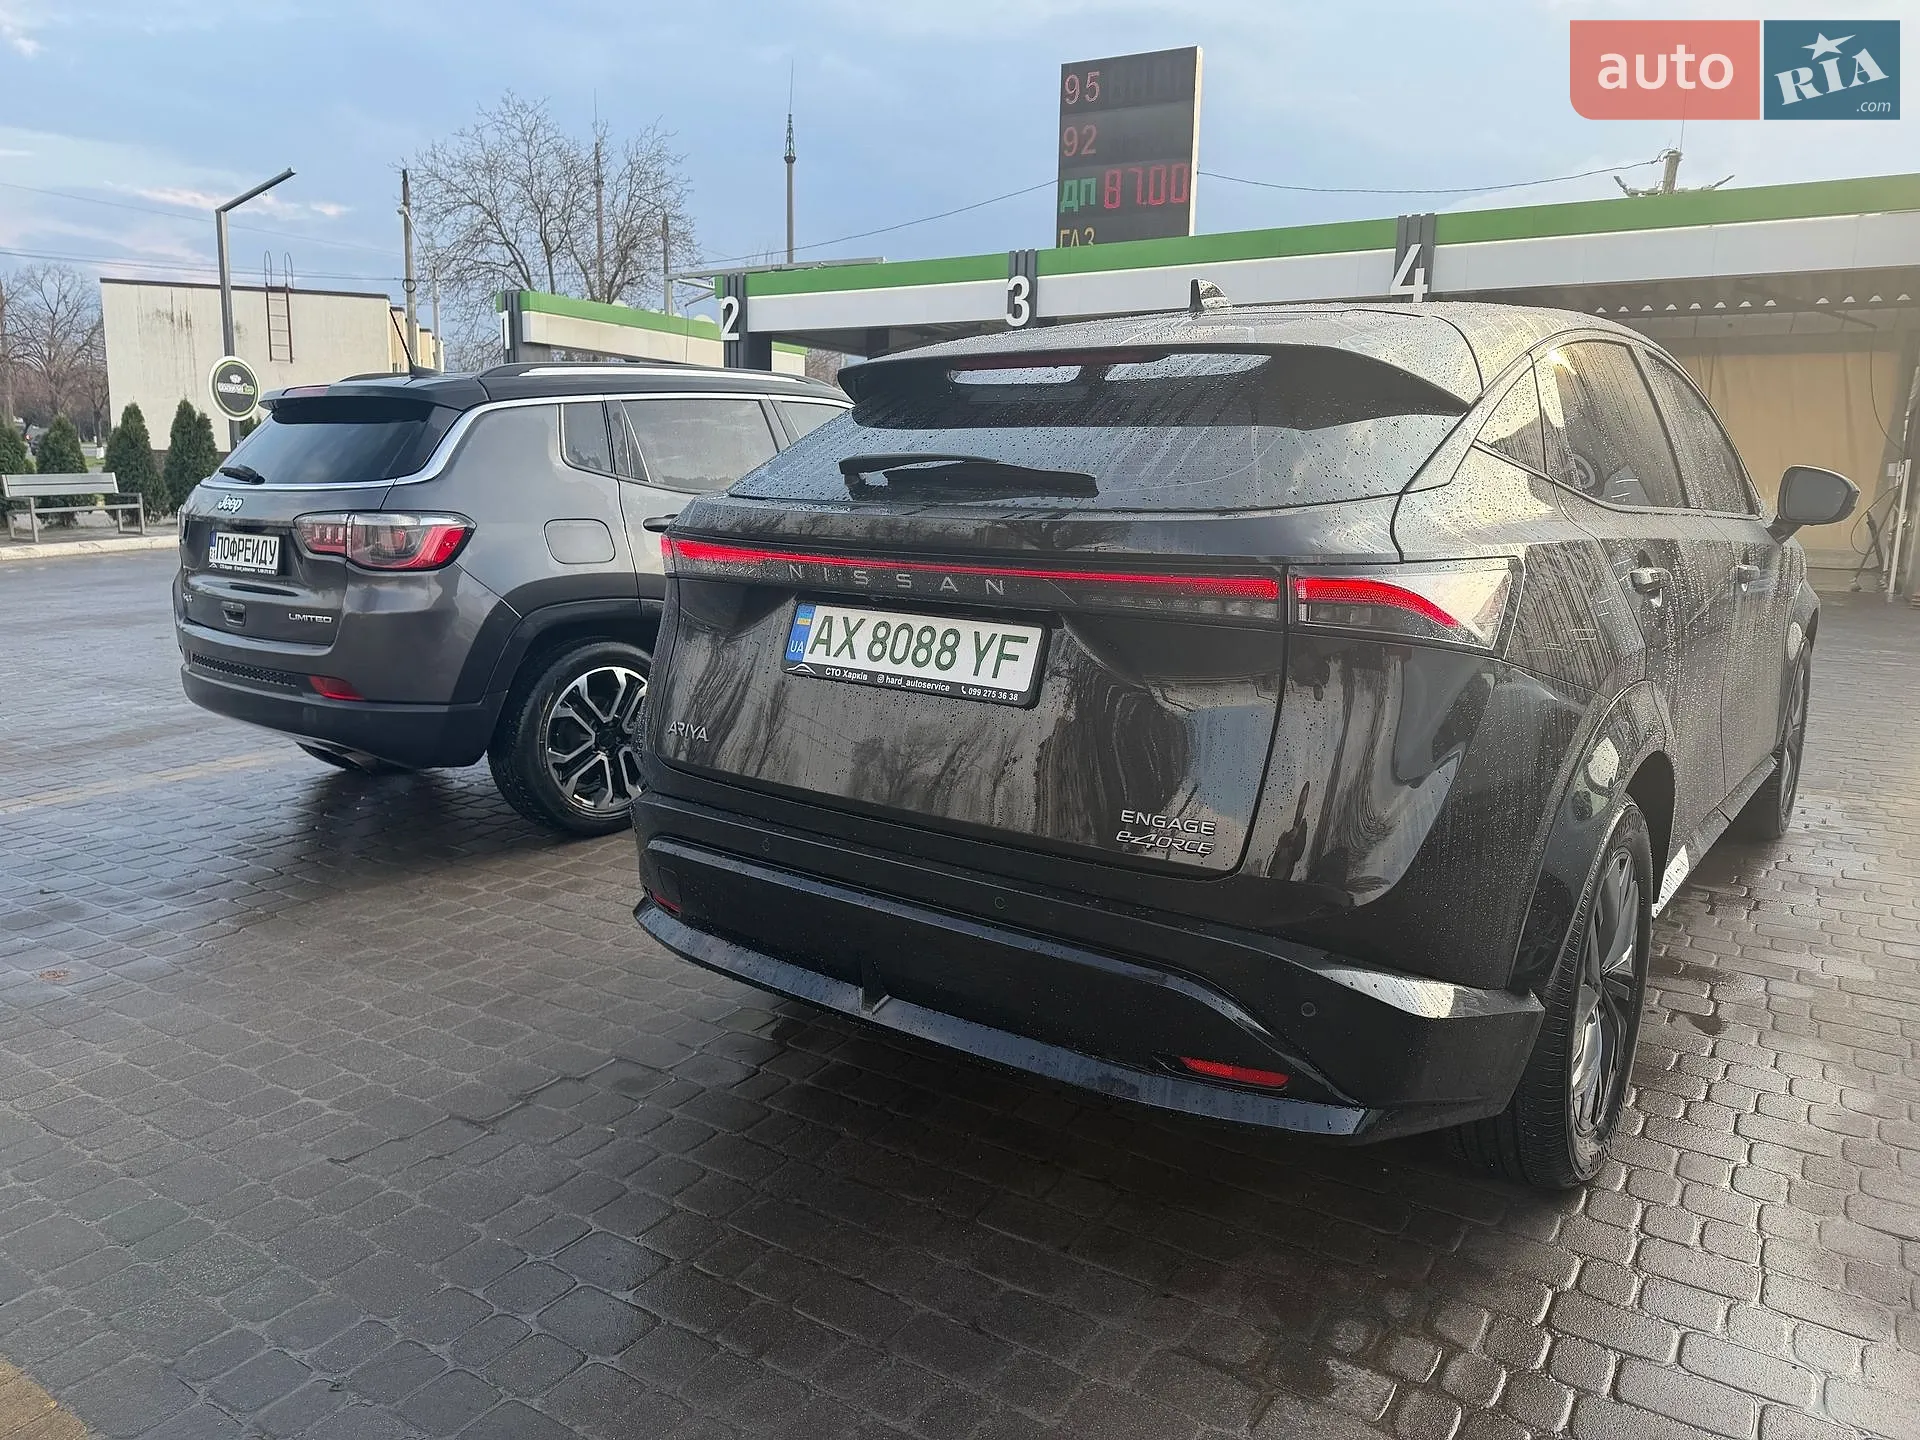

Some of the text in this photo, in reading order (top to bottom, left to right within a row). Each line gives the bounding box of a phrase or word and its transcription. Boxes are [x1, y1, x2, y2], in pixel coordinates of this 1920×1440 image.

[1064, 71, 1101, 105] 95
[1063, 124, 1097, 157] 92
[1390, 243, 1428, 302] 4
[1006, 275, 1030, 327] 3
[720, 296, 740, 341] 2
[217, 494, 243, 513] Jeep
[787, 564, 1005, 596] NISSAN
[288, 612, 333, 624] LIMITED
[790, 640, 804, 654] UA
[808, 615, 1029, 679] AX 8088 YF
[825, 667, 841, 677] СТО
[885, 675, 950, 692] hard_autoservice
[968, 687, 1019, 701] 099 275 36 38
[667, 721, 711, 742] ARIYA
[1121, 809, 1216, 835] ENGAGE
